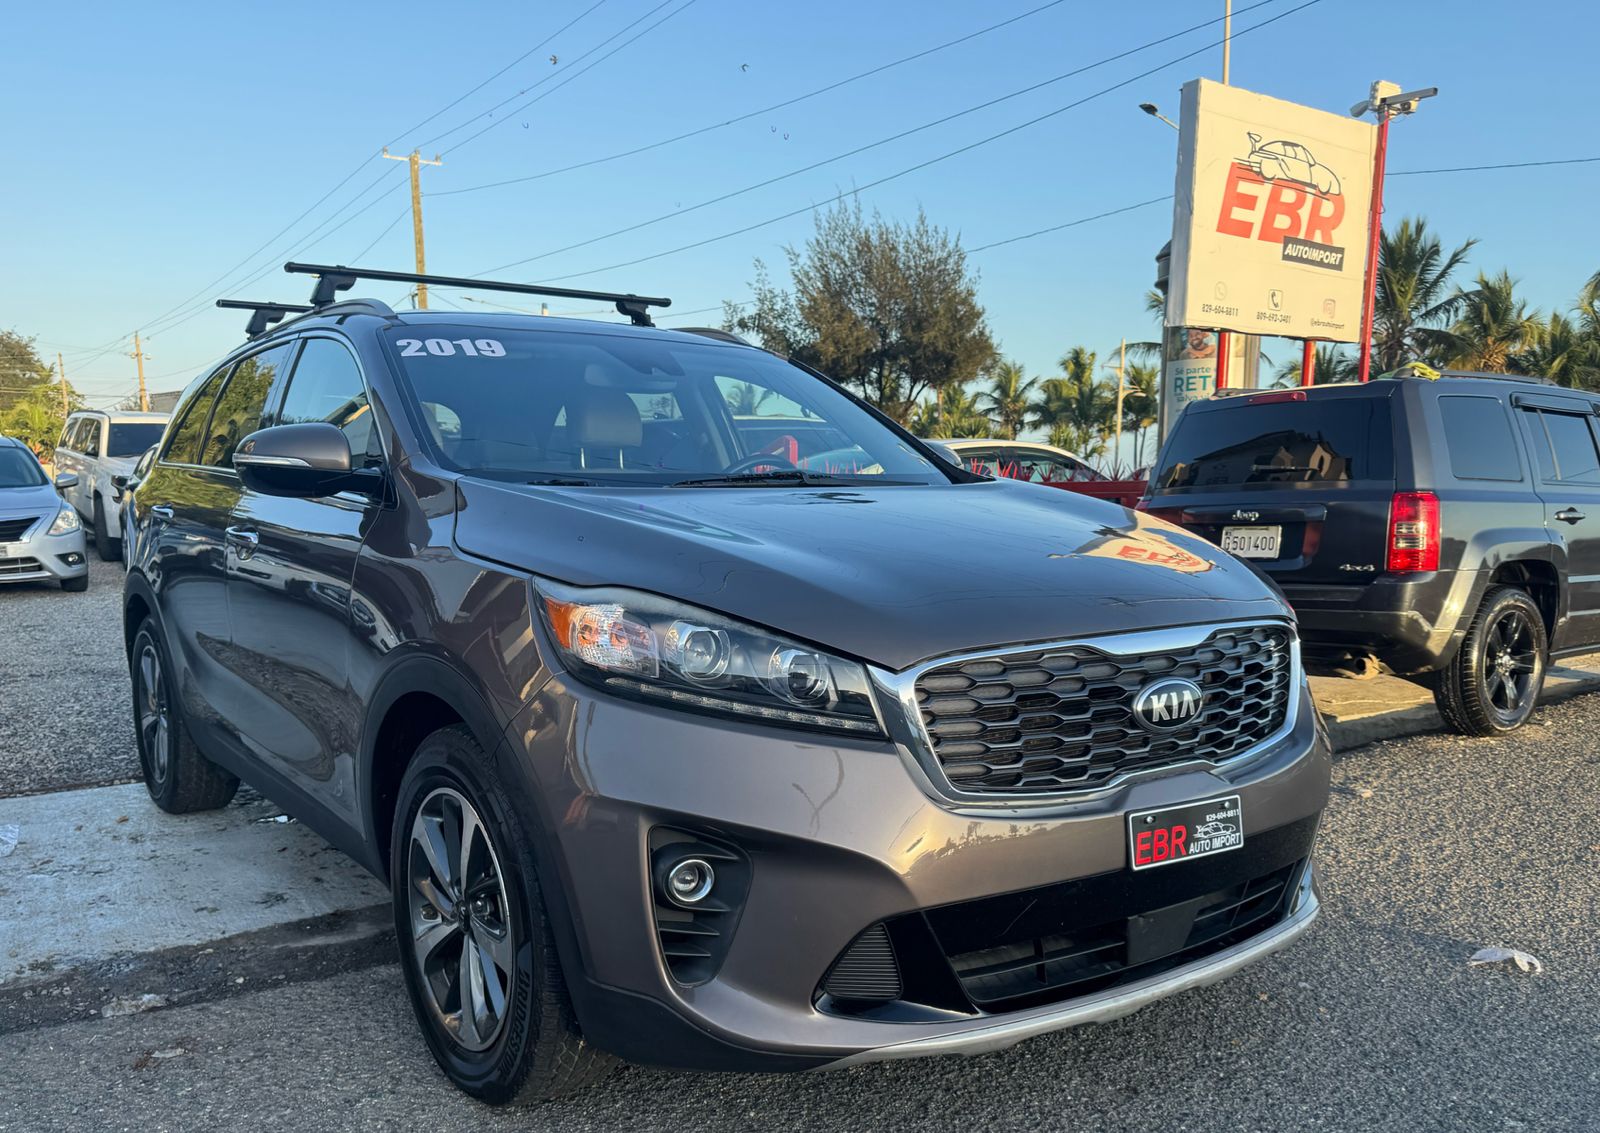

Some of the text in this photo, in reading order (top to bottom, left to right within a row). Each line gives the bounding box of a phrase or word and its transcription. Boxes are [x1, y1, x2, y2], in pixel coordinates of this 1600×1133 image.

[1216, 162, 1345, 245] EBR
[1284, 243, 1343, 265] AUTOIMPORT
[396, 338, 507, 357] 2019
[1232, 509, 1259, 521] Jeep
[1224, 536, 1275, 551] G501400
[1150, 690, 1196, 722] KIA
[1135, 825, 1187, 866] EBR
[1188, 832, 1241, 855] AUTO IMPORT
